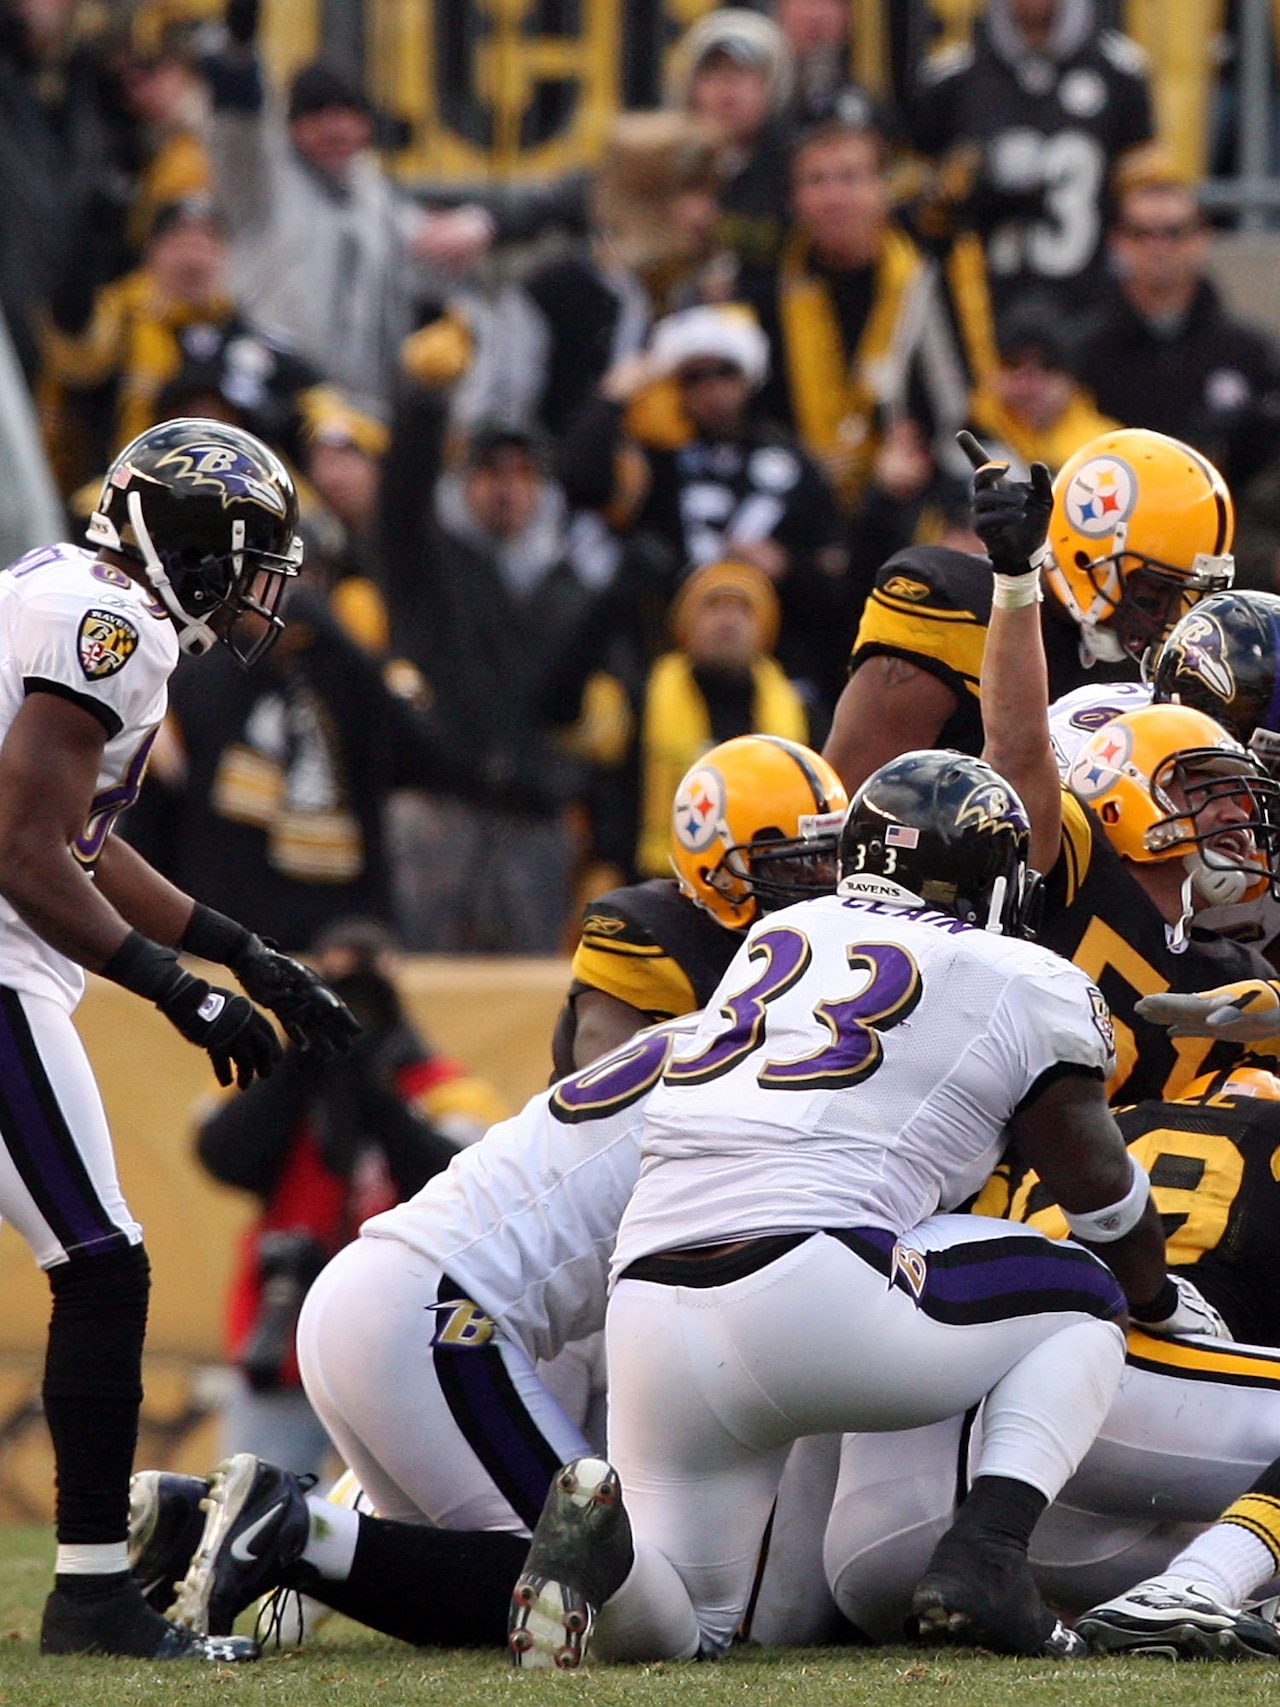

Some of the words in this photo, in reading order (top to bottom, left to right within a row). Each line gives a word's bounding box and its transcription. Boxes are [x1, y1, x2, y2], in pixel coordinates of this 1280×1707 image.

[846, 881, 901, 897] RAVENS
[663, 925, 924, 1091] 33
[424, 1298, 496, 1347] B
